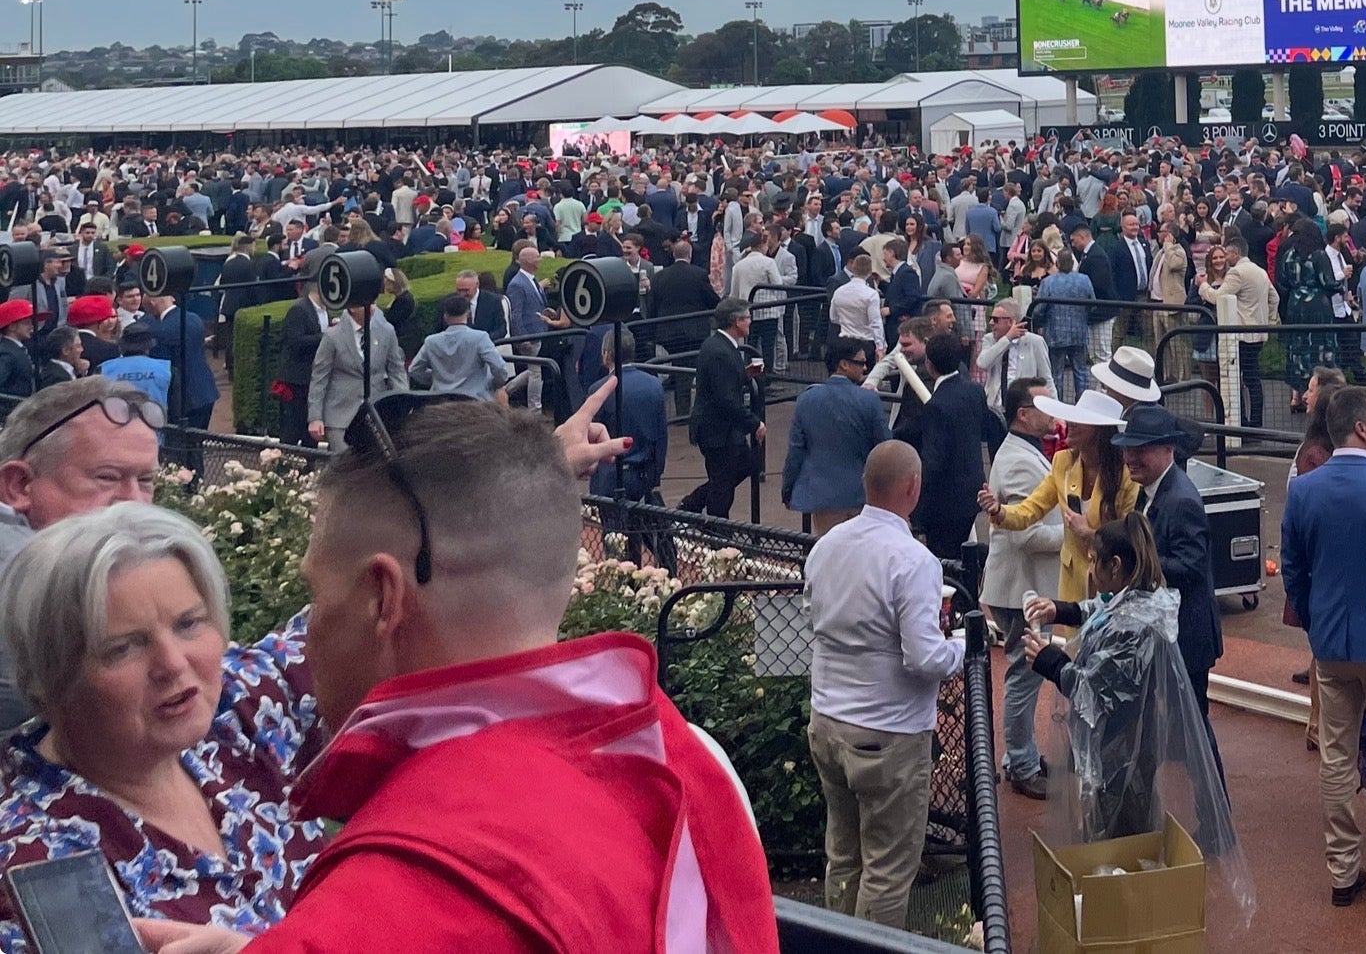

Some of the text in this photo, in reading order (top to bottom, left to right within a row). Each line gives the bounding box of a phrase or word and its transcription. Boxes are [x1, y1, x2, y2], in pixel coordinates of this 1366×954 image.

[1168, 16, 1261, 28] Moonee Valley Racing Club
[1203, 125, 1247, 140] 3 POINT
[1318, 123, 1366, 139] 3 POINT
[1, 251, 10, 281] 3
[146, 254, 158, 289] 4
[329, 265, 340, 301] 5
[573, 273, 593, 315] 6
[117, 371, 156, 381] MEDIA
